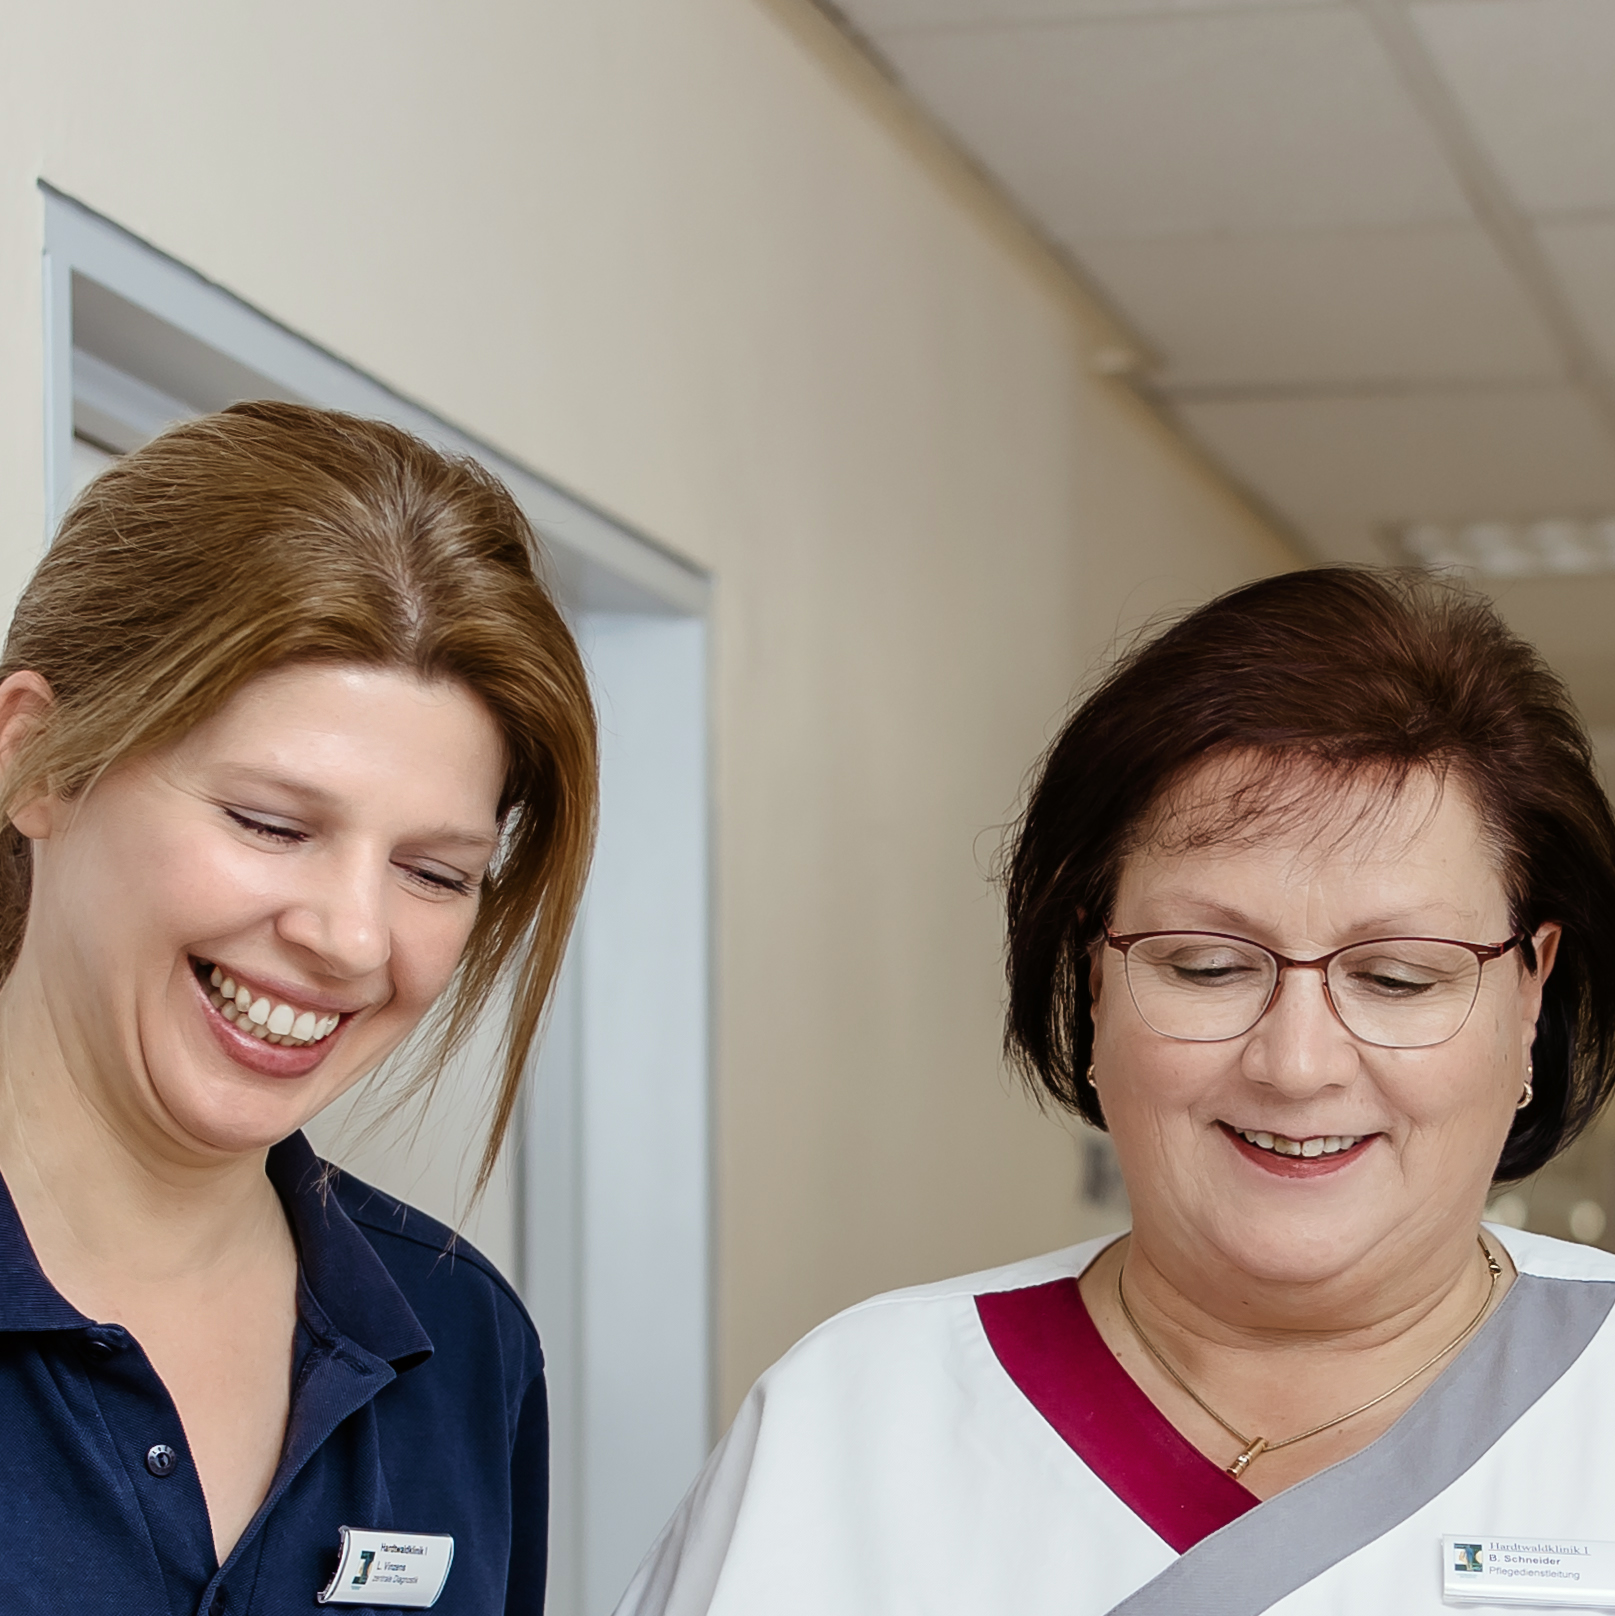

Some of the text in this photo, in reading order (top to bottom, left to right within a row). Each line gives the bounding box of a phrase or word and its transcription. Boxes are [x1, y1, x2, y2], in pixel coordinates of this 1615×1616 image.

[1489, 1542, 1581, 1555] Hardtwaldklinik
[1504, 1555, 1561, 1565] Schneider
[1489, 1566, 1581, 1580] Pflegedienstleitung
